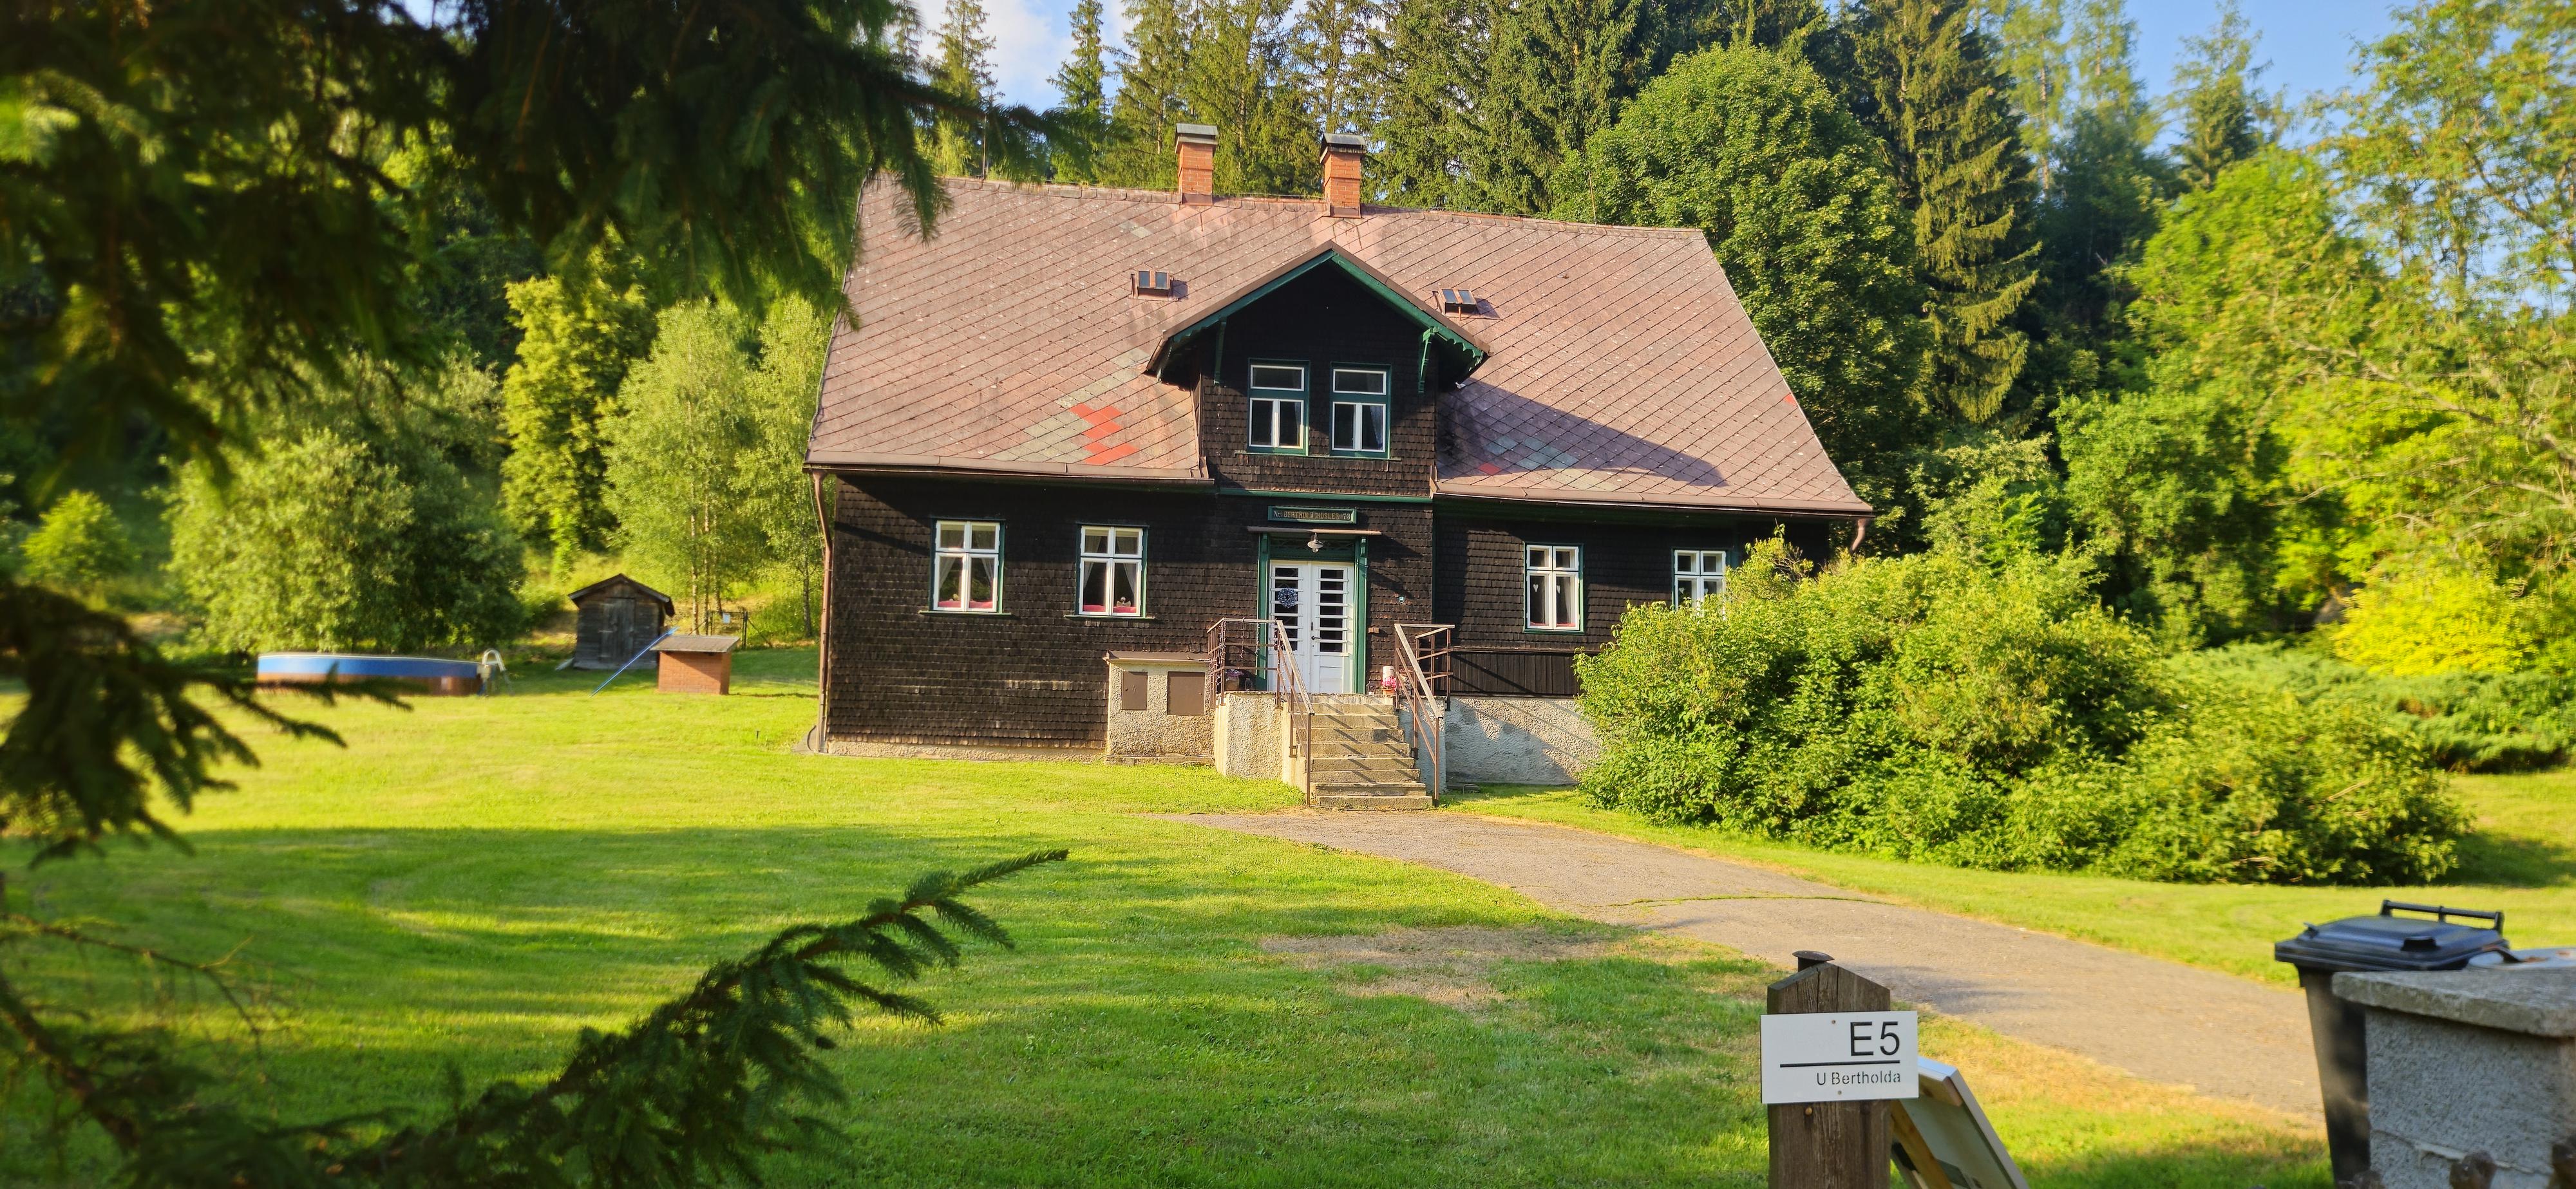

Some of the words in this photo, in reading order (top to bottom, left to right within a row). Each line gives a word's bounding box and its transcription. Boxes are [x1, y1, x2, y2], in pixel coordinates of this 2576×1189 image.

[1850, 1021, 1900, 1056] E5
[1817, 1072, 1826, 1085] U
[1832, 1070, 1900, 1085] Bertholda
